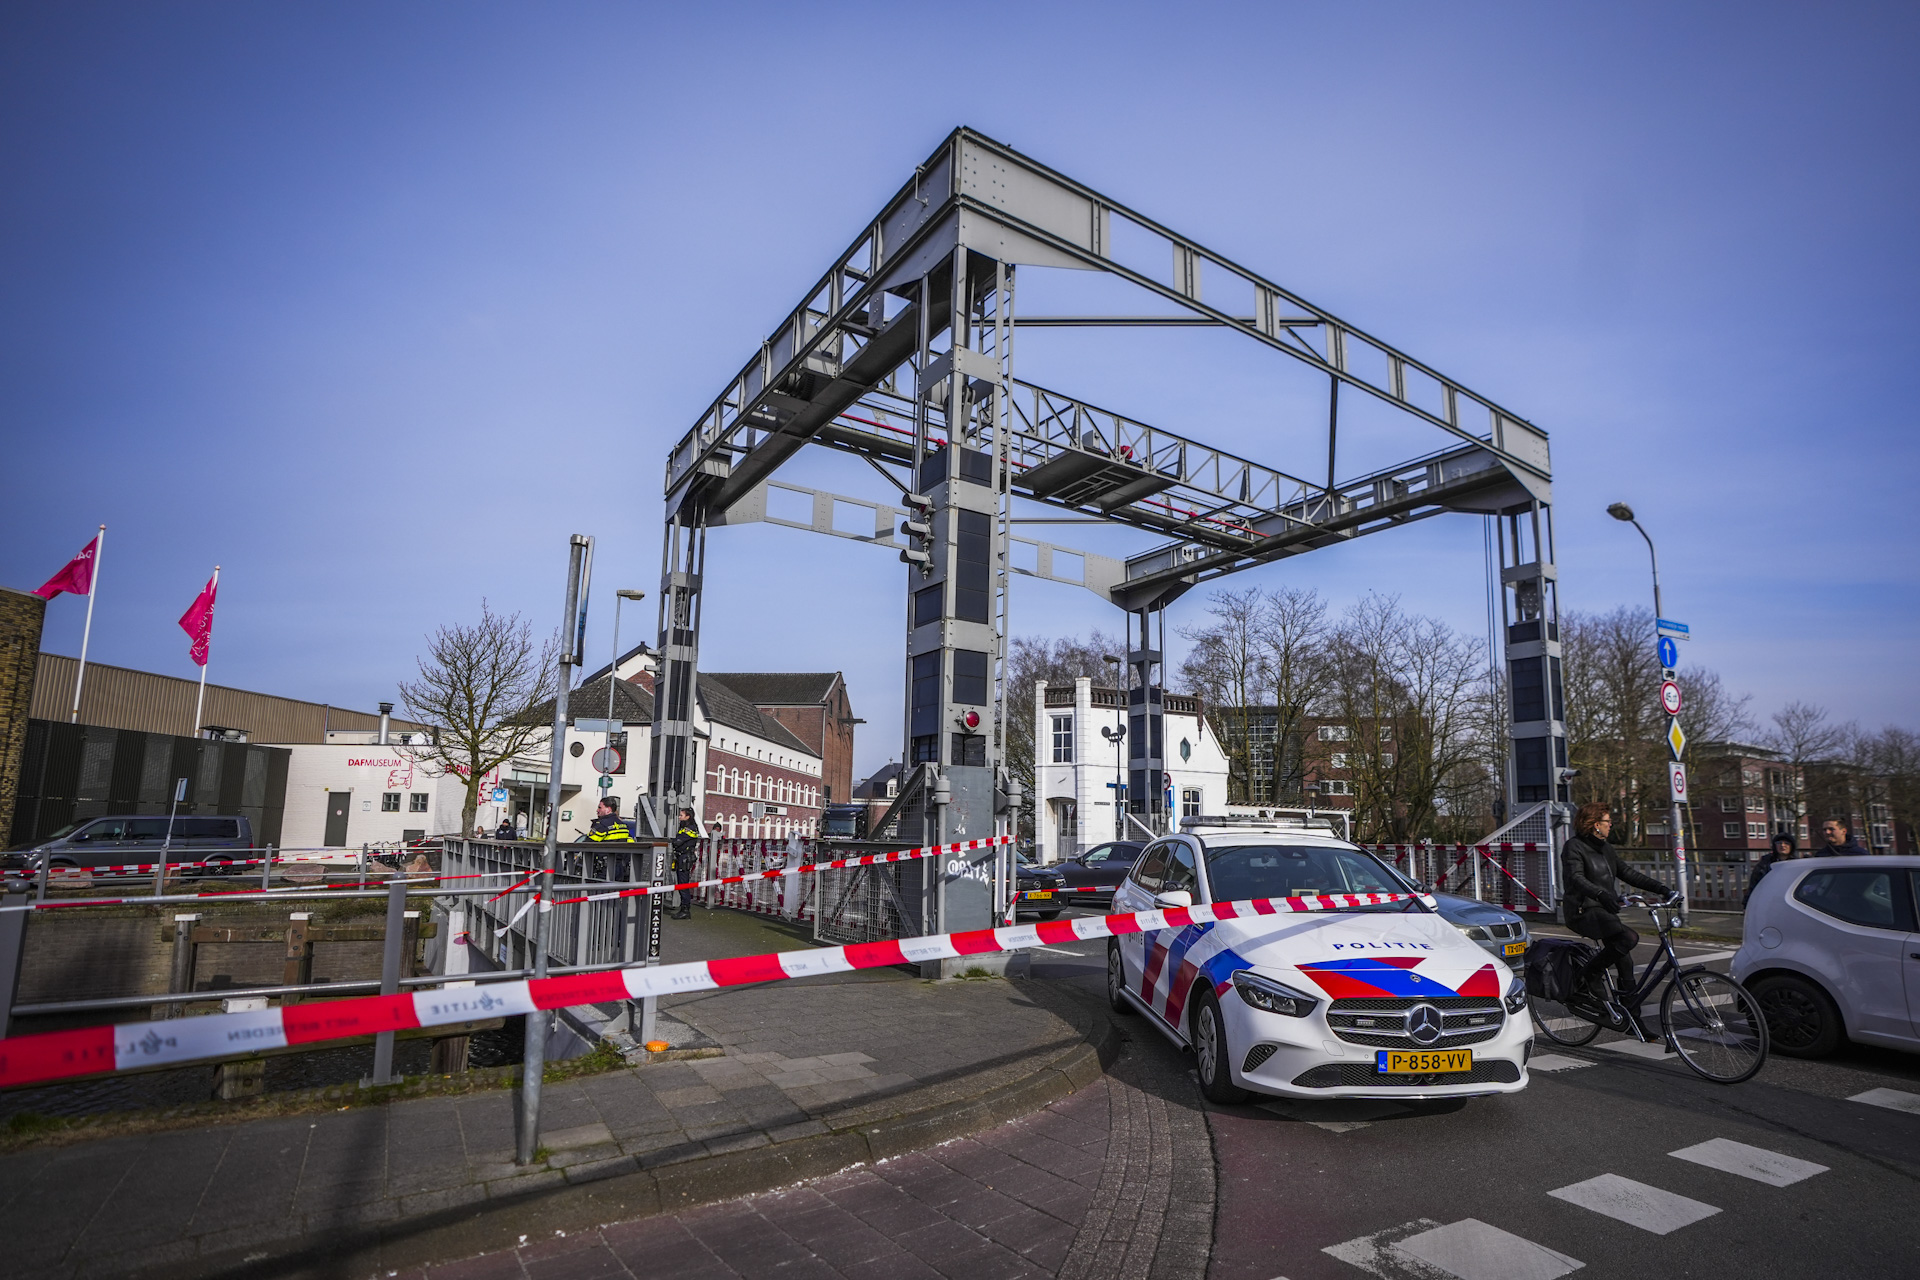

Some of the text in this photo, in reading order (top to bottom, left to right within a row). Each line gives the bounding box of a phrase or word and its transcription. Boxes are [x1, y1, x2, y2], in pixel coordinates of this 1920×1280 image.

[348, 759, 401, 767] DAFMUSEUM
[1676, 778, 1683, 787] 30
[655, 856, 664, 877] PSV
[653, 881, 662, 906] GLD
[651, 909, 661, 946] TATTOO
[1332, 942, 1434, 950] POLITIE
[1393, 1054, 1465, 1070] P-858-VV
